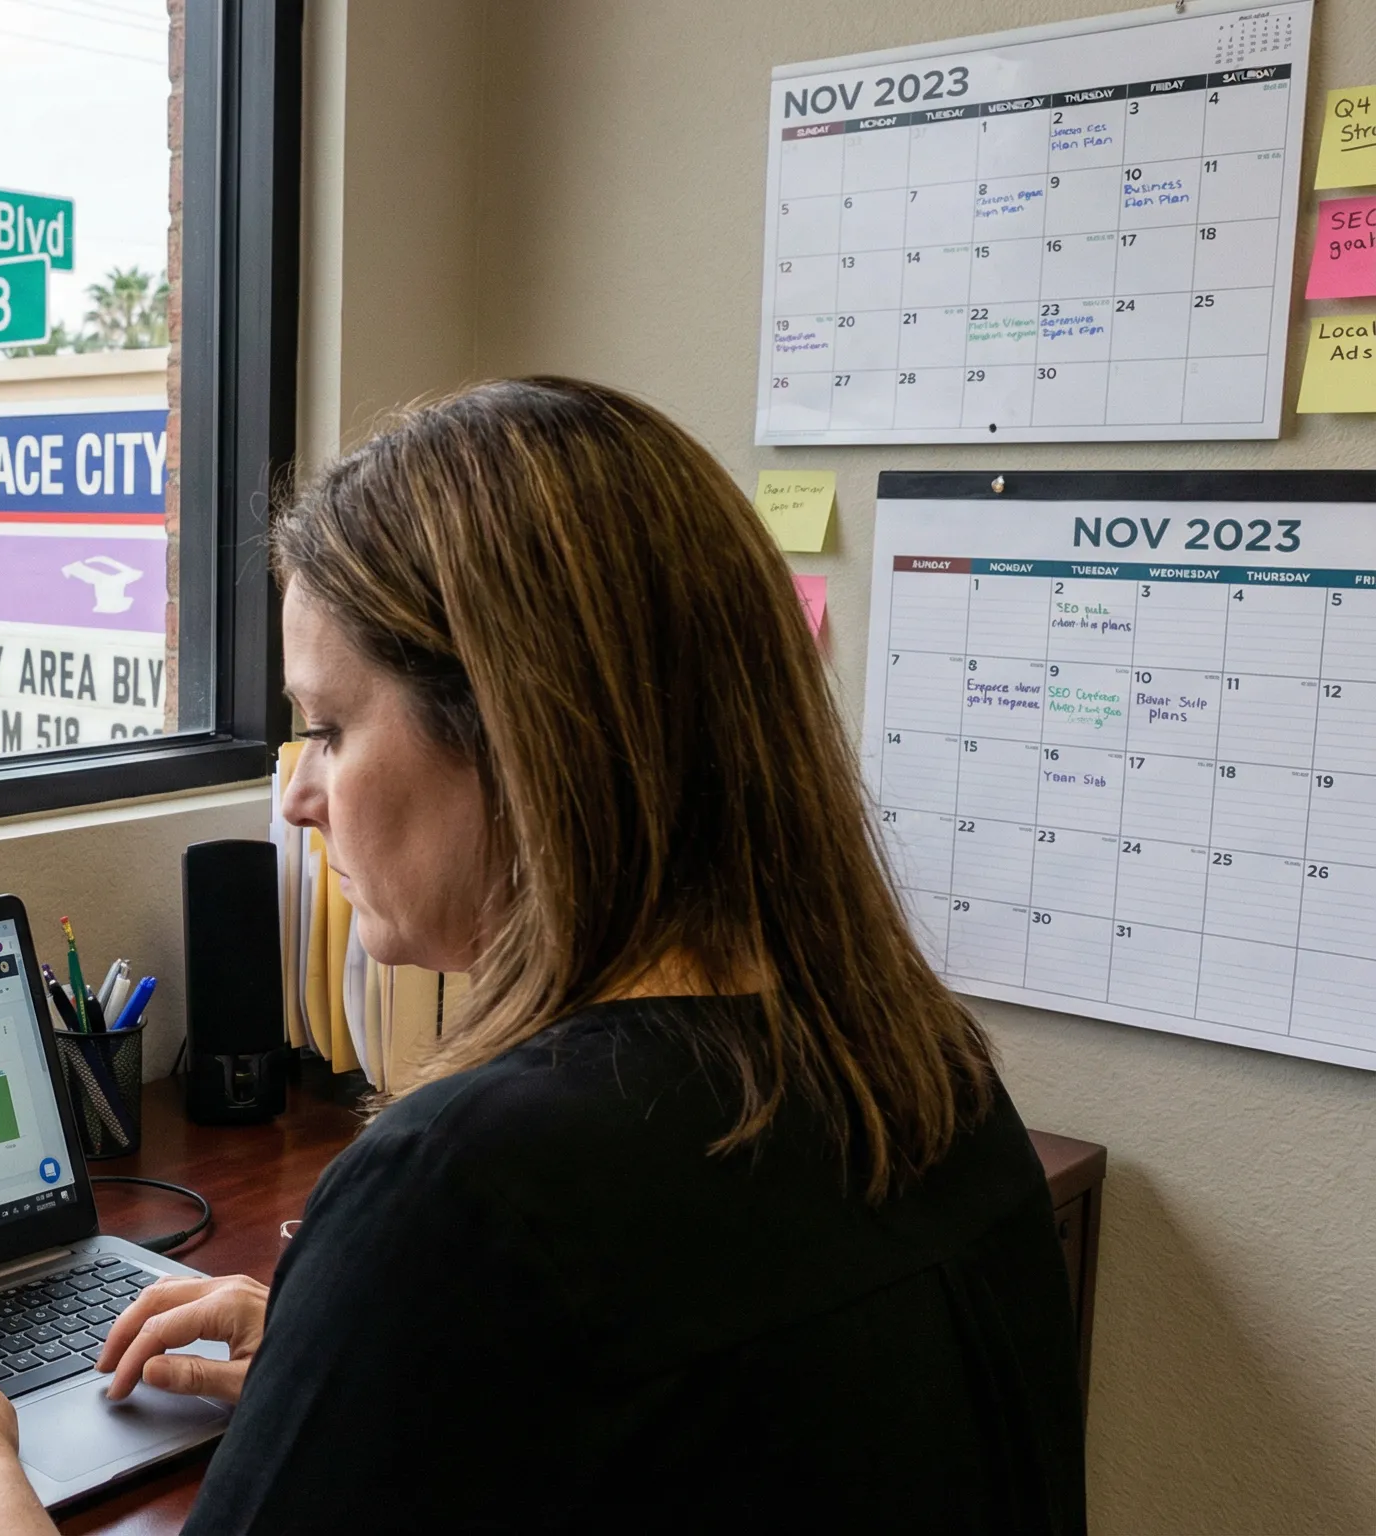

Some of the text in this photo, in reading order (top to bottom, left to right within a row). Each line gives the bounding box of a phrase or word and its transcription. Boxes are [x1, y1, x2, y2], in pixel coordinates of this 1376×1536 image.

[784, 67, 969, 118] NOV 2023
[1209, 92, 1219, 105] 4
[1129, 102, 1139, 114] 3
[1335, 96, 1371, 118] Q4
[1053, 112, 1064, 124] 2
[982, 121, 987, 133] 1
[1204, 161, 1218, 173] 11
[1125, 168, 1142, 181] 10
[1050, 177, 1060, 189] 9
[978, 184, 988, 195] 8
[909, 191, 918, 202] 7
[844, 197, 853, 209] 6
[781, 204, 789, 215] 5
[1200, 227, 1216, 240] 18
[1046, 240, 1062, 252] 16
[1121, 234, 1137, 247] 17
[1330, 232, 1376, 260] goal
[906, 252, 921, 264] 14
[975, 247, 990, 258] 15
[779, 262, 792, 273] 12
[841, 257, 855, 269] 13
[1115, 300, 1135, 312] 24
[1194, 295, 1214, 308] 25
[970, 308, 989, 320] 22
[1041, 304, 1060, 316] 23
[837, 316, 855, 328] 20
[903, 313, 917, 325] 21
[776, 320, 789, 332] 19
[1319, 321, 1376, 339] Local
[1330, 345, 1372, 361] Ads
[899, 373, 916, 385] 28
[967, 370, 985, 382] 29
[1037, 368, 1056, 380] 30
[773, 377, 789, 388] 26
[834, 375, 851, 387] 27
[75, 431, 167, 495] CITY
[1073, 517, 1302, 553] NOV 2023
[974, 579, 979, 590] 1
[1055, 582, 1064, 594] 2
[1141, 585, 1151, 597] 3
[1233, 589, 1244, 601] 4
[1331, 593, 1342, 606] 5
[891, 654, 900, 665] 7
[968, 660, 977, 671] 8
[19, 648, 97, 701] AREA
[1050, 665, 1059, 677] 9
[1134, 671, 1152, 684] 10
[1227, 677, 1240, 691] 11
[1324, 685, 1342, 698] 12
[1149, 709, 1187, 723] plans
[887, 733, 901, 744] 14
[964, 740, 978, 752] 15
[1044, 749, 1059, 761] 16
[1129, 756, 1145, 769] 17
[1219, 765, 1236, 779] 18
[1316, 775, 1334, 788] 19
[883, 811, 897, 822] 21
[958, 821, 975, 833] 22
[1038, 830, 1055, 843] 23
[1122, 841, 1141, 854] 24
[1213, 852, 1232, 866] 25
[1307, 865, 1328, 879] 26
[953, 900, 970, 911] 29
[1032, 911, 1051, 924] 30
[1116, 925, 1132, 938] 31
